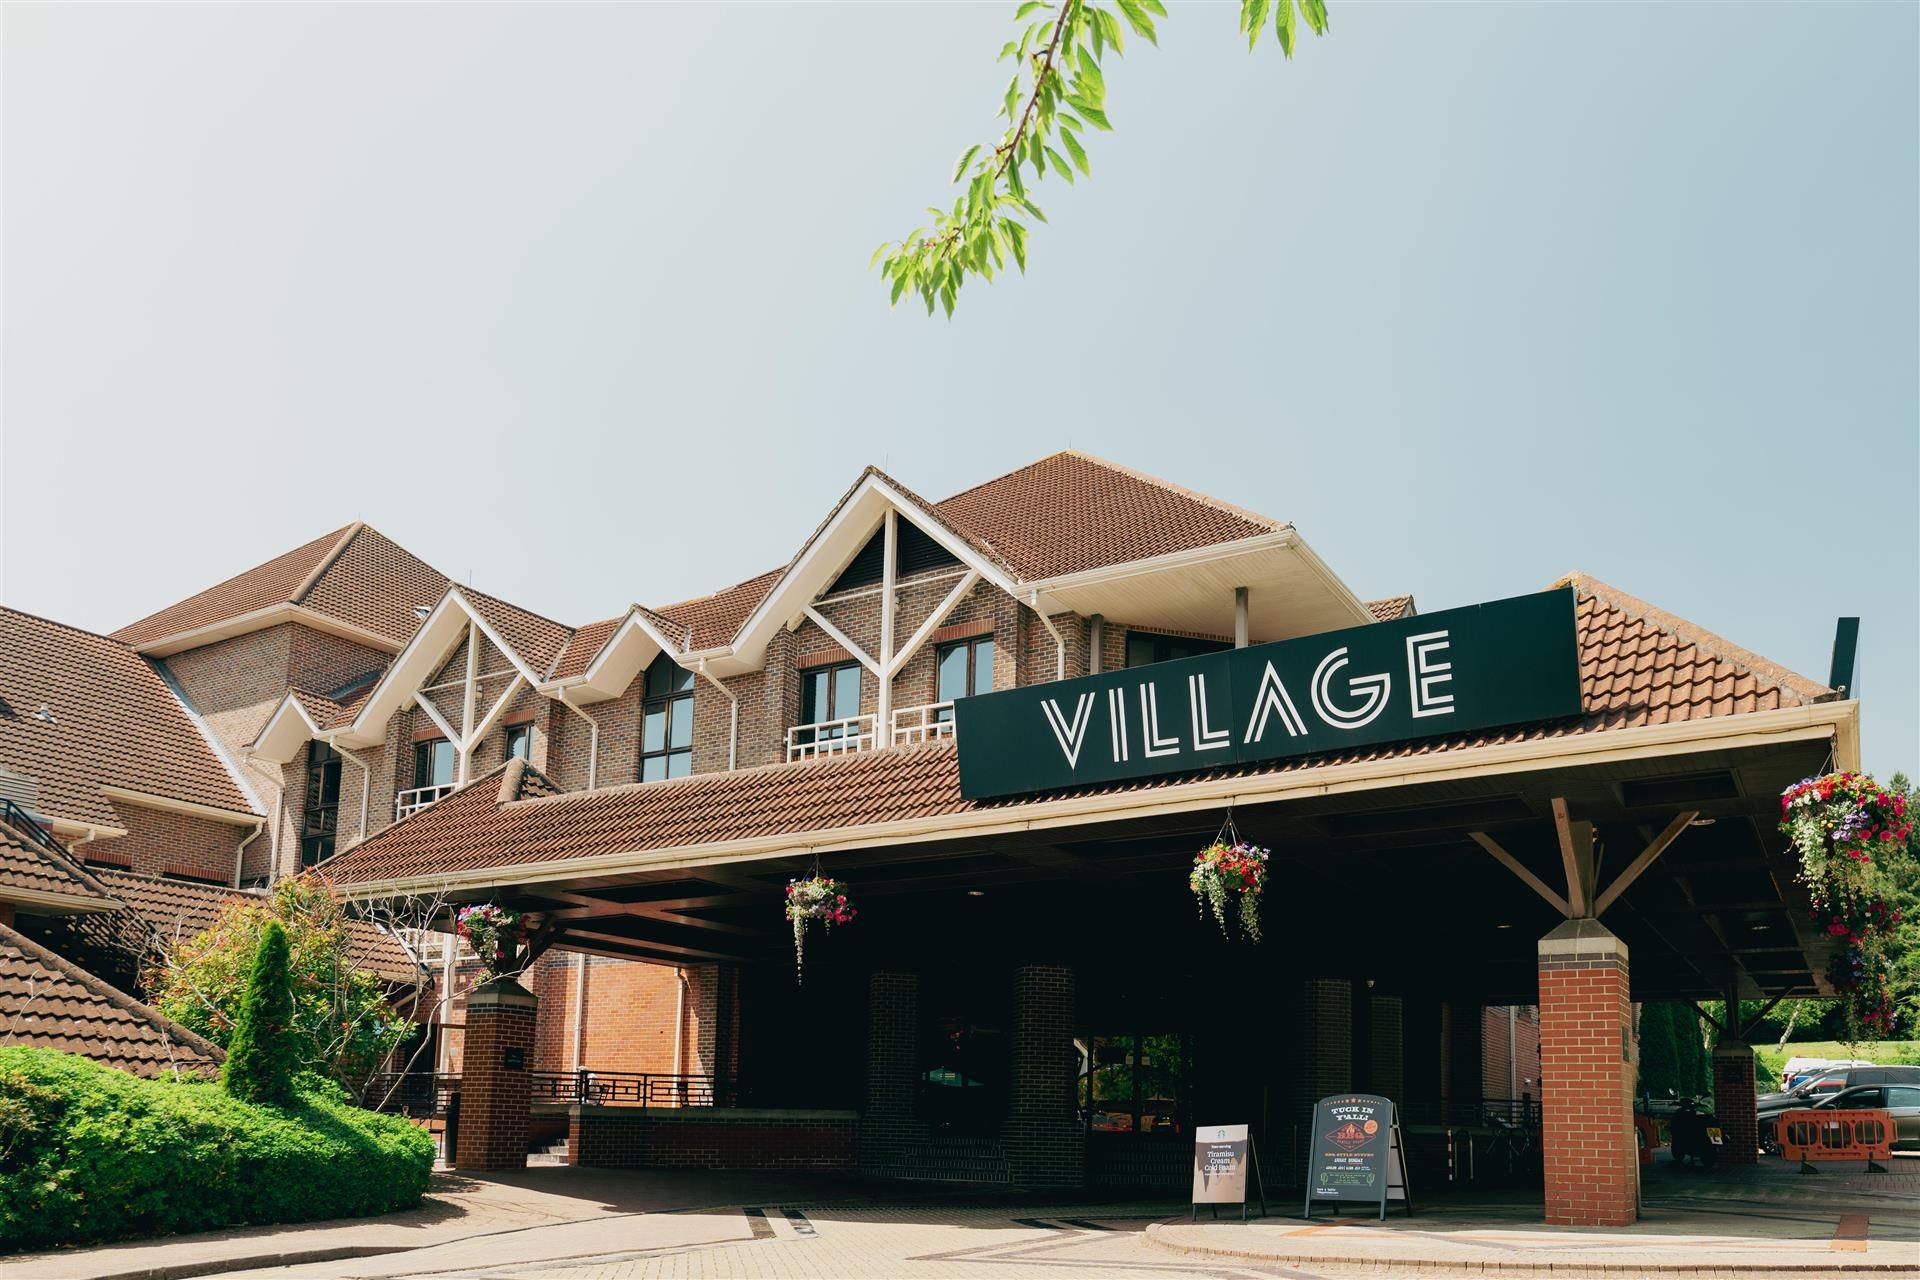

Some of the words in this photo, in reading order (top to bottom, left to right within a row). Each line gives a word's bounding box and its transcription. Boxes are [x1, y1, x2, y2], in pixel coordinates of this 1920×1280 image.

[1041, 630, 1455, 770] VILLAGE
[1331, 1107, 1360, 1115] TUCK
[1361, 1107, 1374, 1115] IN
[1336, 1132, 1365, 1140] BBQ
